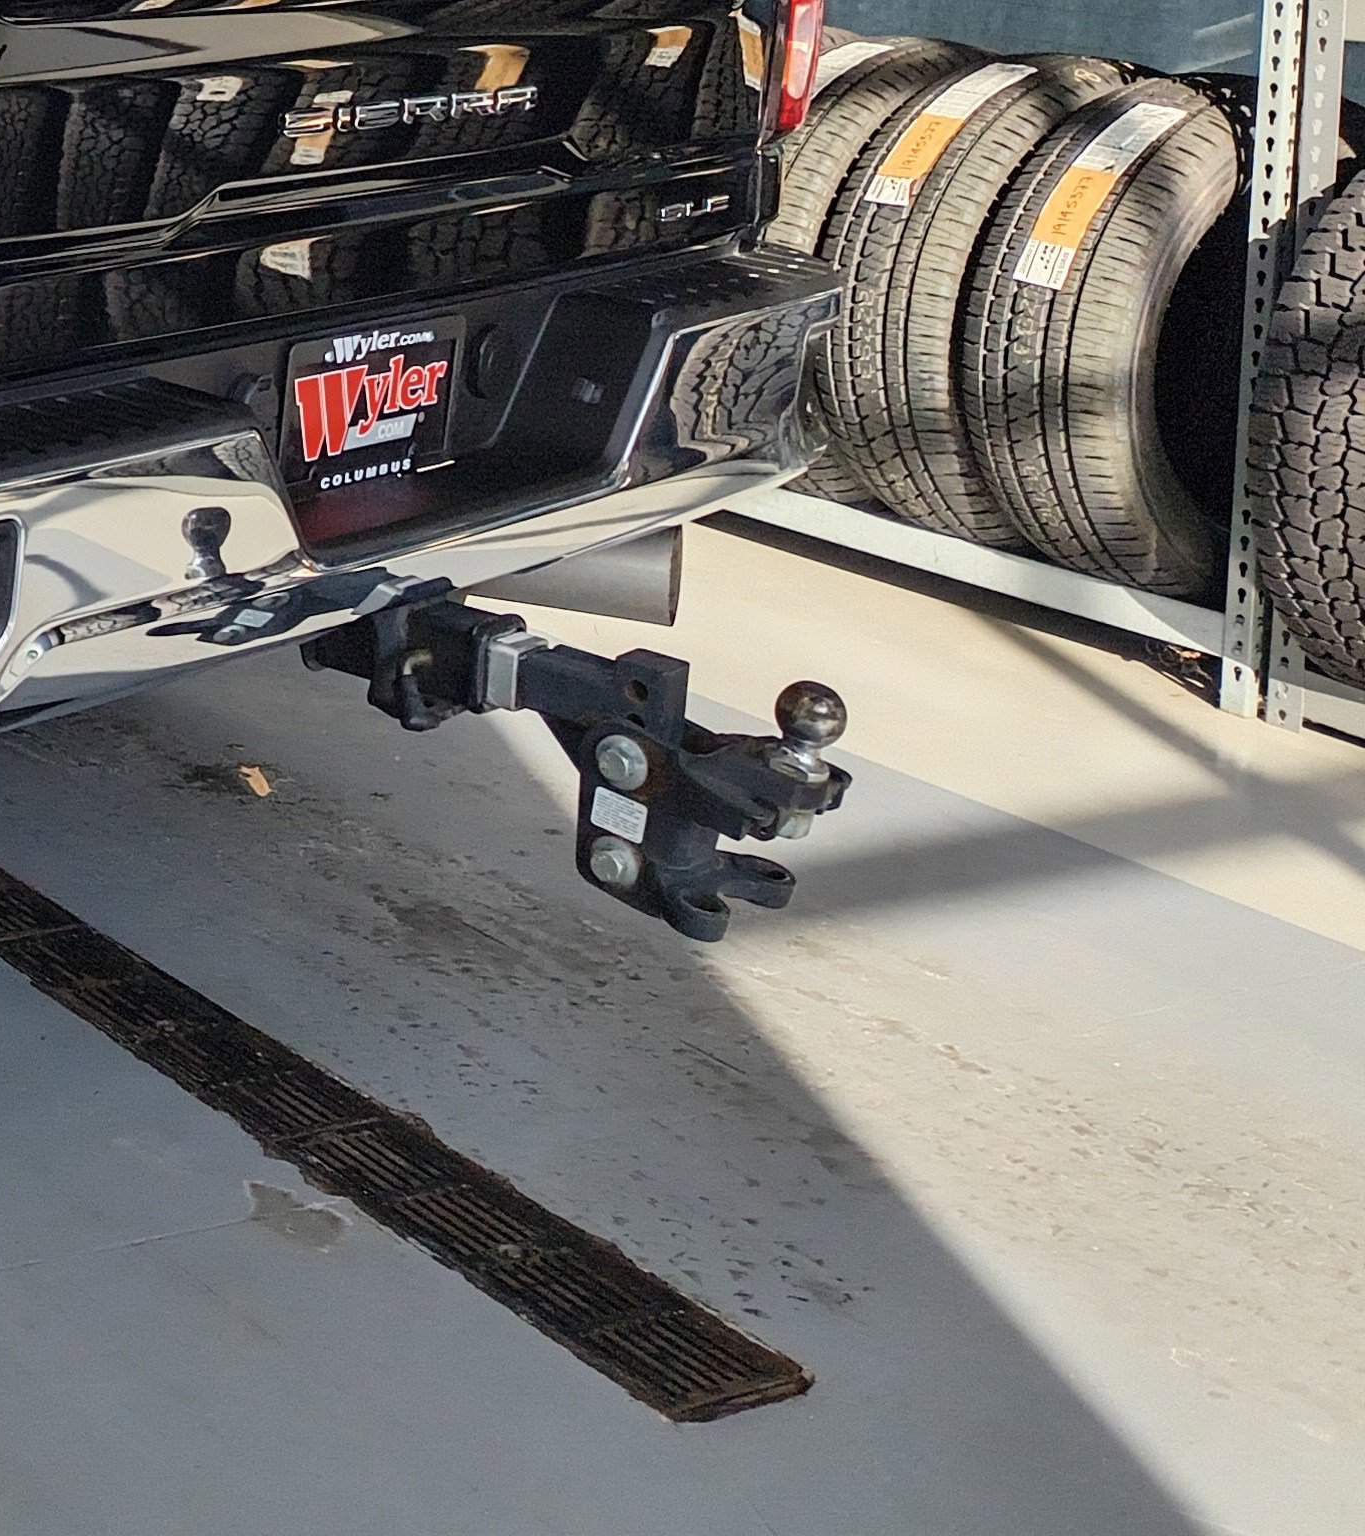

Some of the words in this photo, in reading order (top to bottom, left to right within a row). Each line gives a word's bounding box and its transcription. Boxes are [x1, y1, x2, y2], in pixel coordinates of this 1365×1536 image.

[280, 85, 539, 139] SIERRA
[1050, 176, 1094, 237] 19145377
[294, 354, 448, 462] Wyler
[320, 458, 412, 490] COLUMBUS
